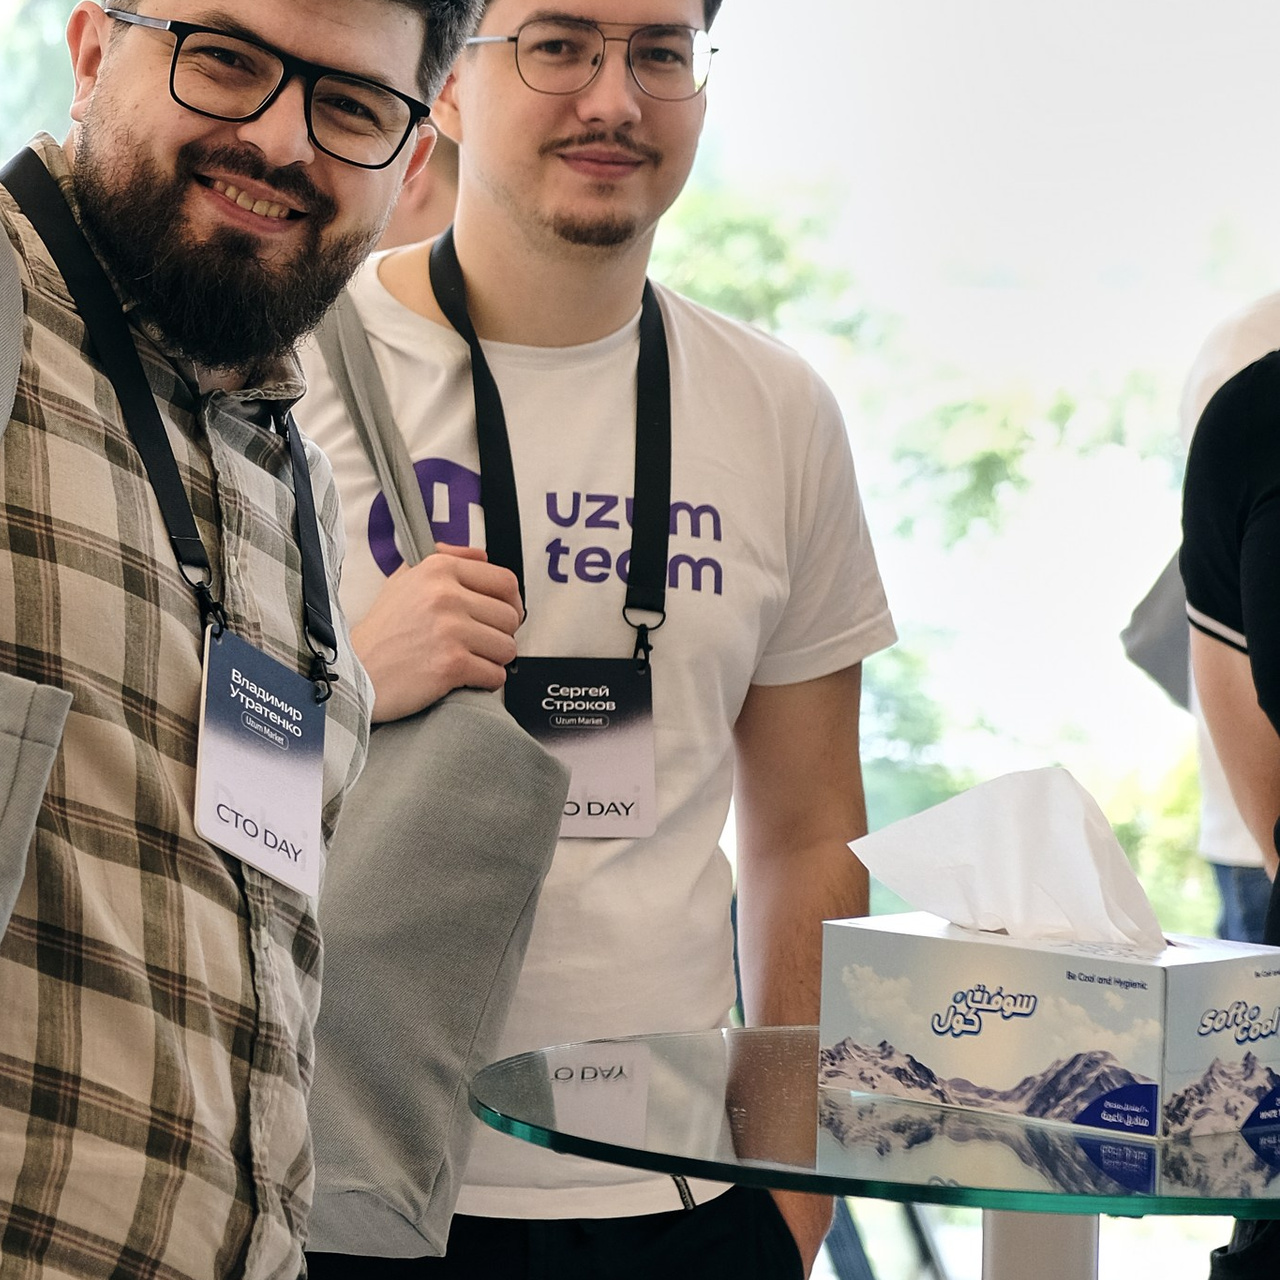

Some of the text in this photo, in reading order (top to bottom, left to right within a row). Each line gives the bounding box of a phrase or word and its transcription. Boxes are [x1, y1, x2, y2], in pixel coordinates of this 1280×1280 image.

[546, 491, 722, 542] uzm
[545, 537, 723, 596] tem
[230, 683, 303, 738] Утратенко
[231, 668, 303, 722] Владимир
[541, 697, 616, 712] Строков
[547, 683, 610, 699] Сергей
[246, 715, 285, 746] Uzum Market
[555, 716, 603, 726] Uzum Market
[586, 801, 636, 817] DAY
[216, 803, 303, 863] CTO DAY
